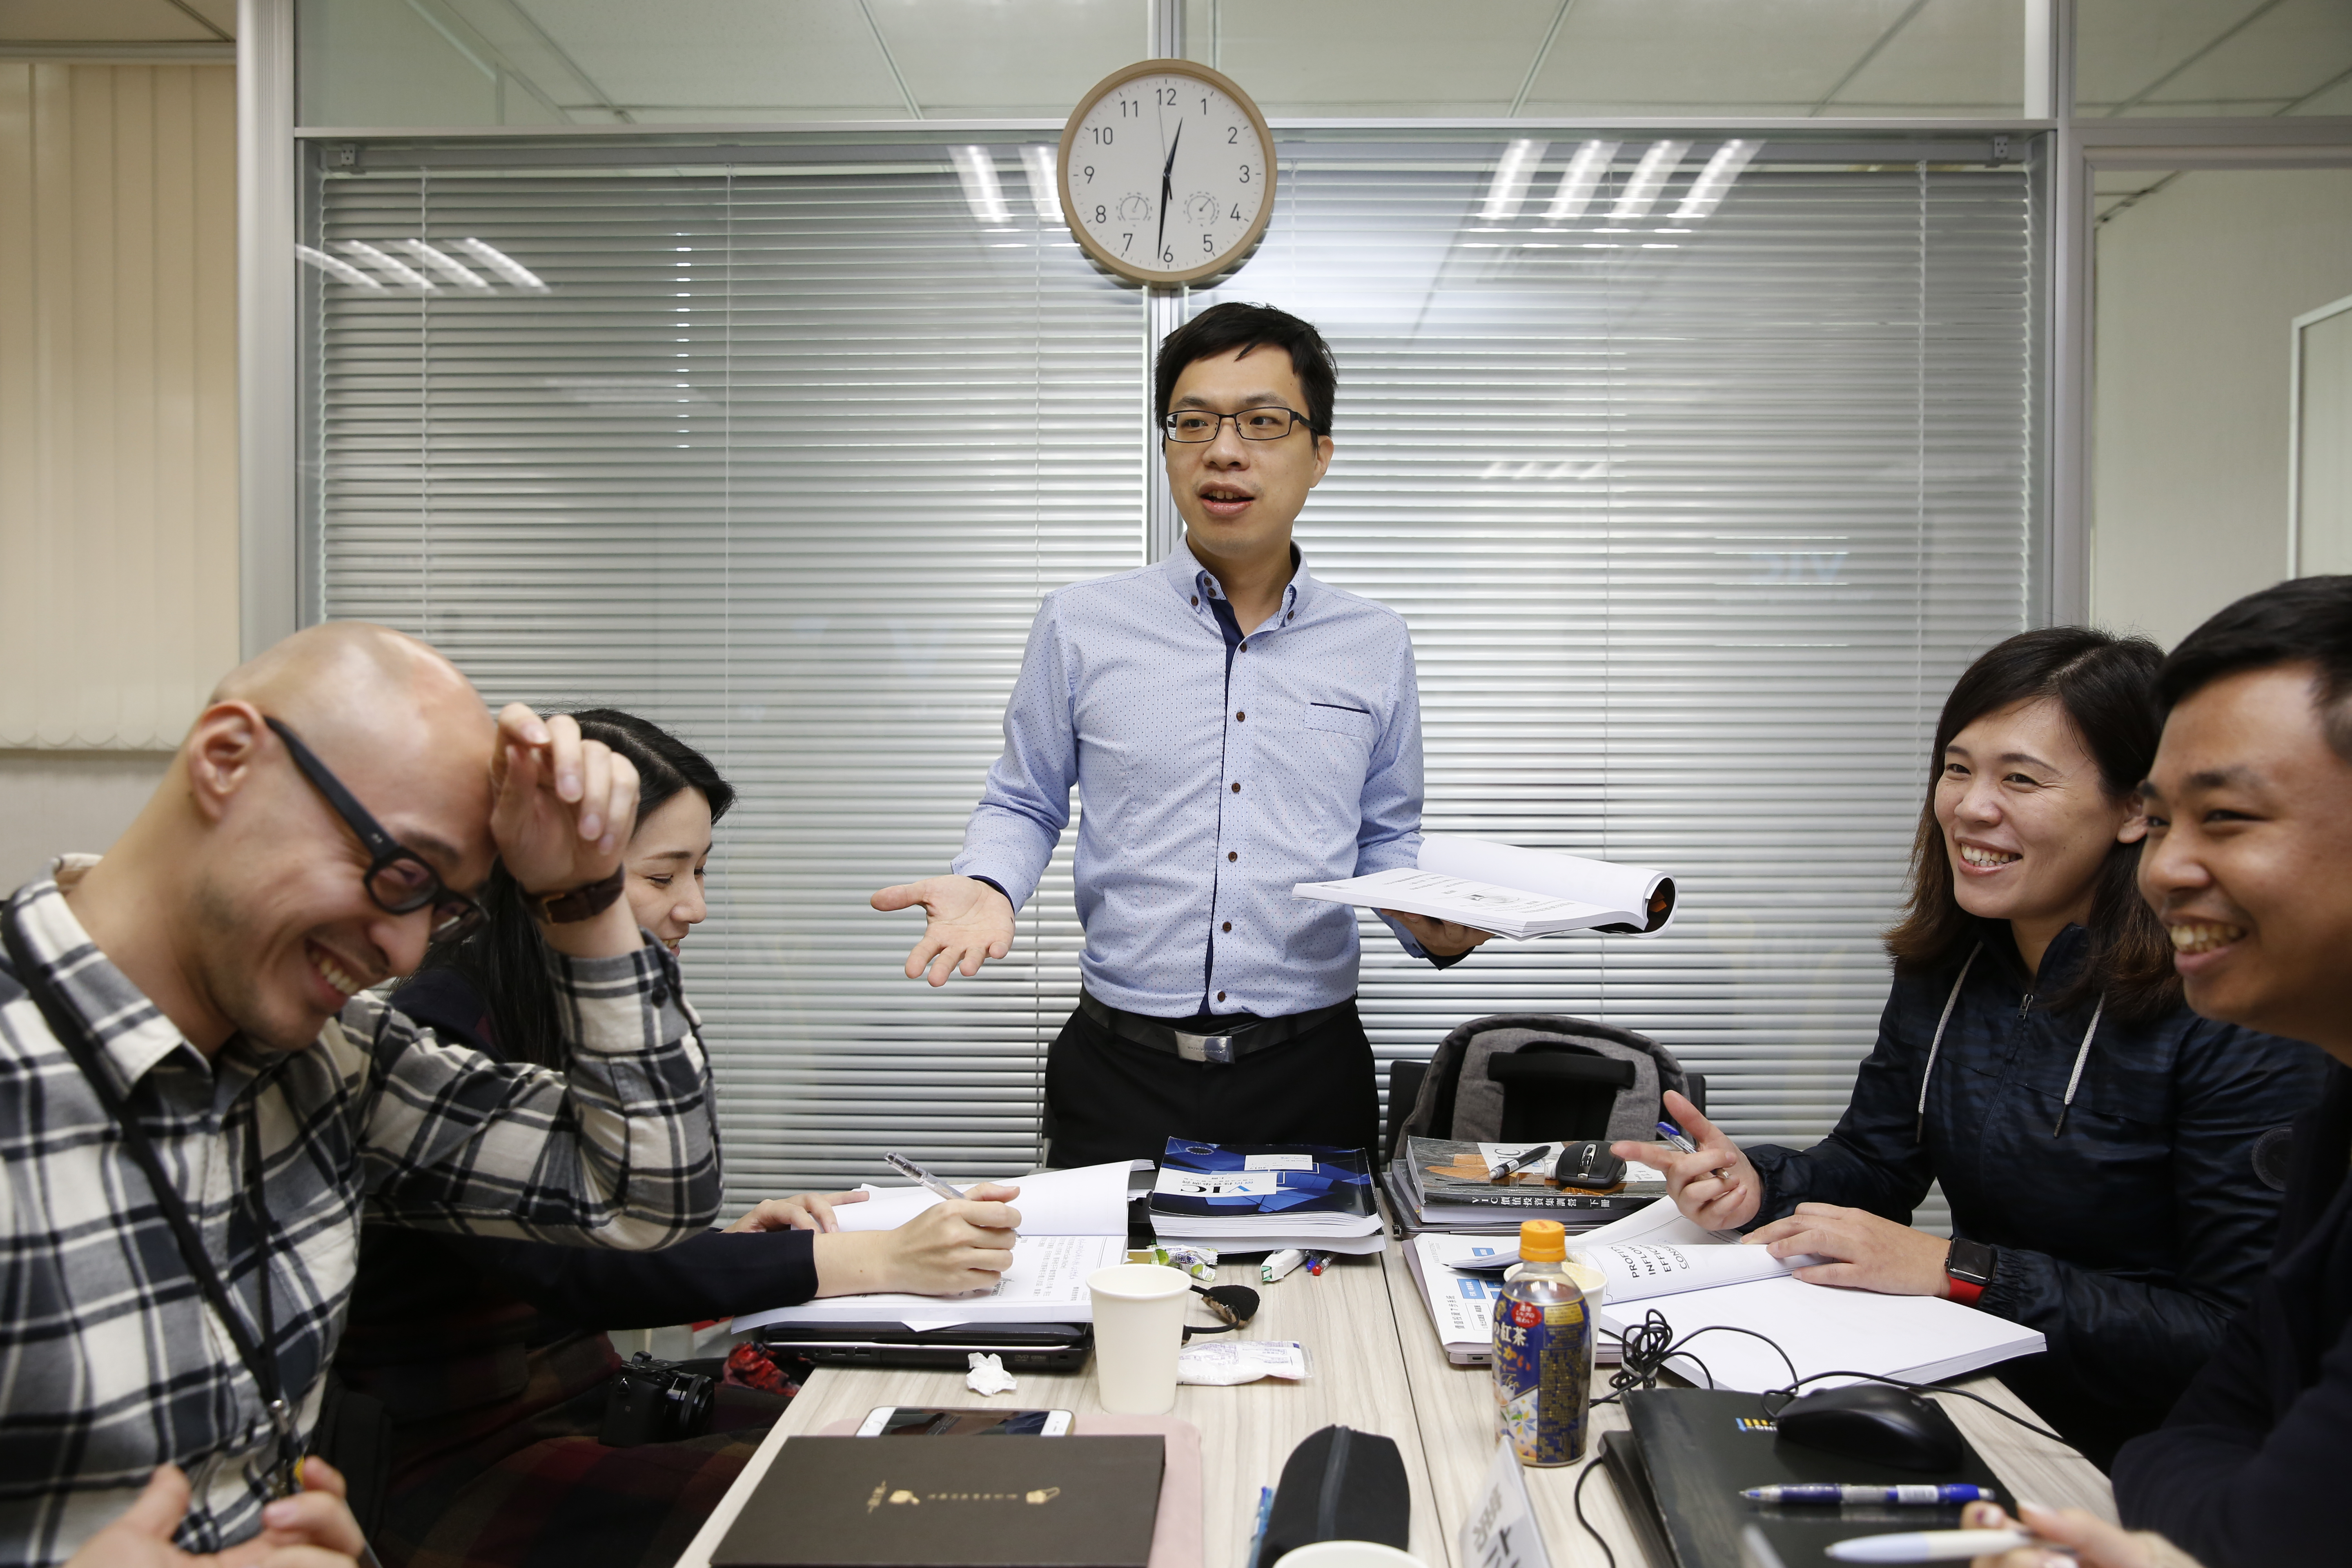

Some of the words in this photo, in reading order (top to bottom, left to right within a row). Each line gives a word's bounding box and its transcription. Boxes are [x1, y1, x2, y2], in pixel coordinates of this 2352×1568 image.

[1157, 89, 1176, 105] 12
[1121, 101, 1138, 117] 11
[1201, 98, 1206, 115] 1
[1093, 127, 1113, 145] 10
[1228, 127, 1237, 144] 2
[1085, 166, 1094, 184] 9
[1239, 165, 1250, 183] 3
[1096, 205, 1106, 223] 8
[1230, 203, 1241, 220] 4
[1123, 234, 1133, 252] 7
[1203, 234, 1212, 252] 5
[1163, 245, 1173, 262] 6
[1180, 1185, 1254, 1193] VIC
[1589, 1198, 1610, 1208] 下冊
[1638, 1245, 1672, 1272] EFFICIE
[998, 1282, 1007, 1296] MALAYSIA
